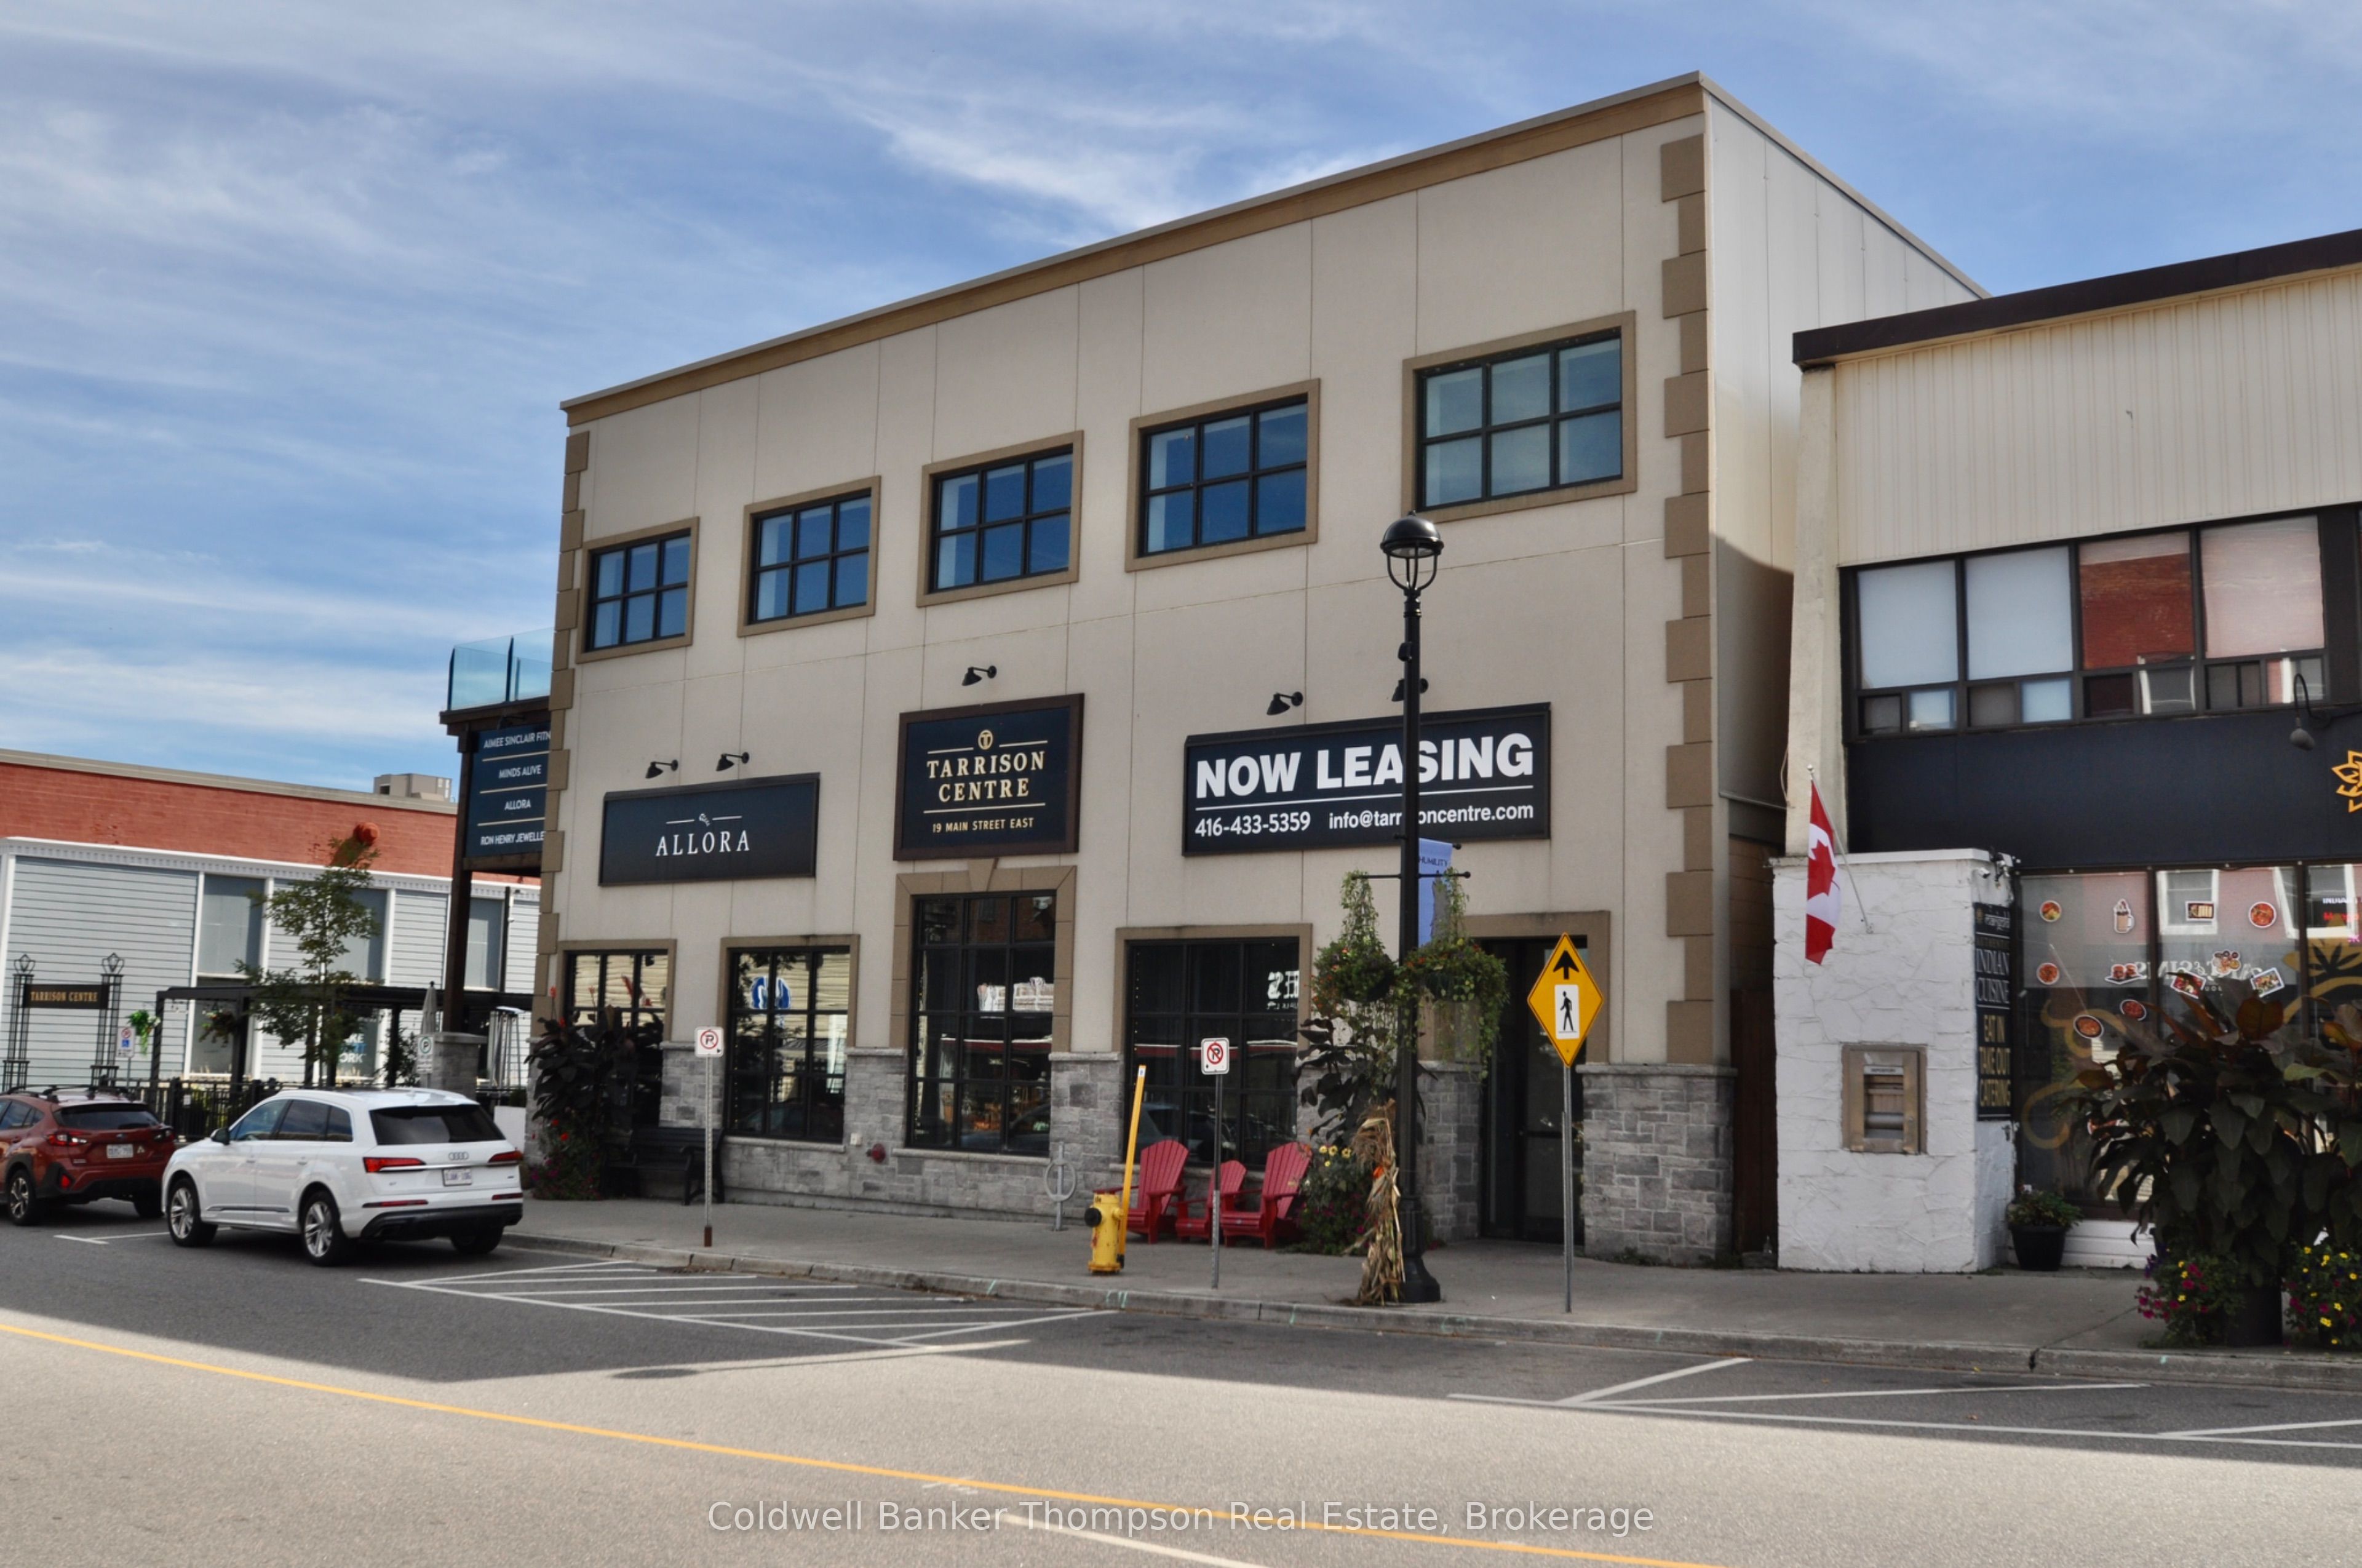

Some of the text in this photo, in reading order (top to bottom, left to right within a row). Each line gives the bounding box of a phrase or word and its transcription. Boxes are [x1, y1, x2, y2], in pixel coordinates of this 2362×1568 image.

[483, 738, 504, 748] AIMEE
[505, 733, 535, 746] SINCLAIR
[499, 765, 542, 779] MINDS ALIVE
[927, 751, 1044, 779] TARRISON
[1196, 733, 1534, 798] NOW LEASING
[939, 778, 1029, 802] CENTRE
[504, 799, 531, 811] ALLORA
[932, 818, 1034, 833] 19 MAIN STREET EAST
[1195, 805, 1533, 837] 416-433-5359 info@tarroncentre.com
[480, 836, 494, 845] RON
[495, 833, 515, 845] HENRY
[656, 830, 750, 857] ALLORA
[1976, 948, 2010, 976] INDIAN
[31, 992, 98, 1001] TARRISON CENTRE
[1976, 977, 2010, 1004] CUISINE
